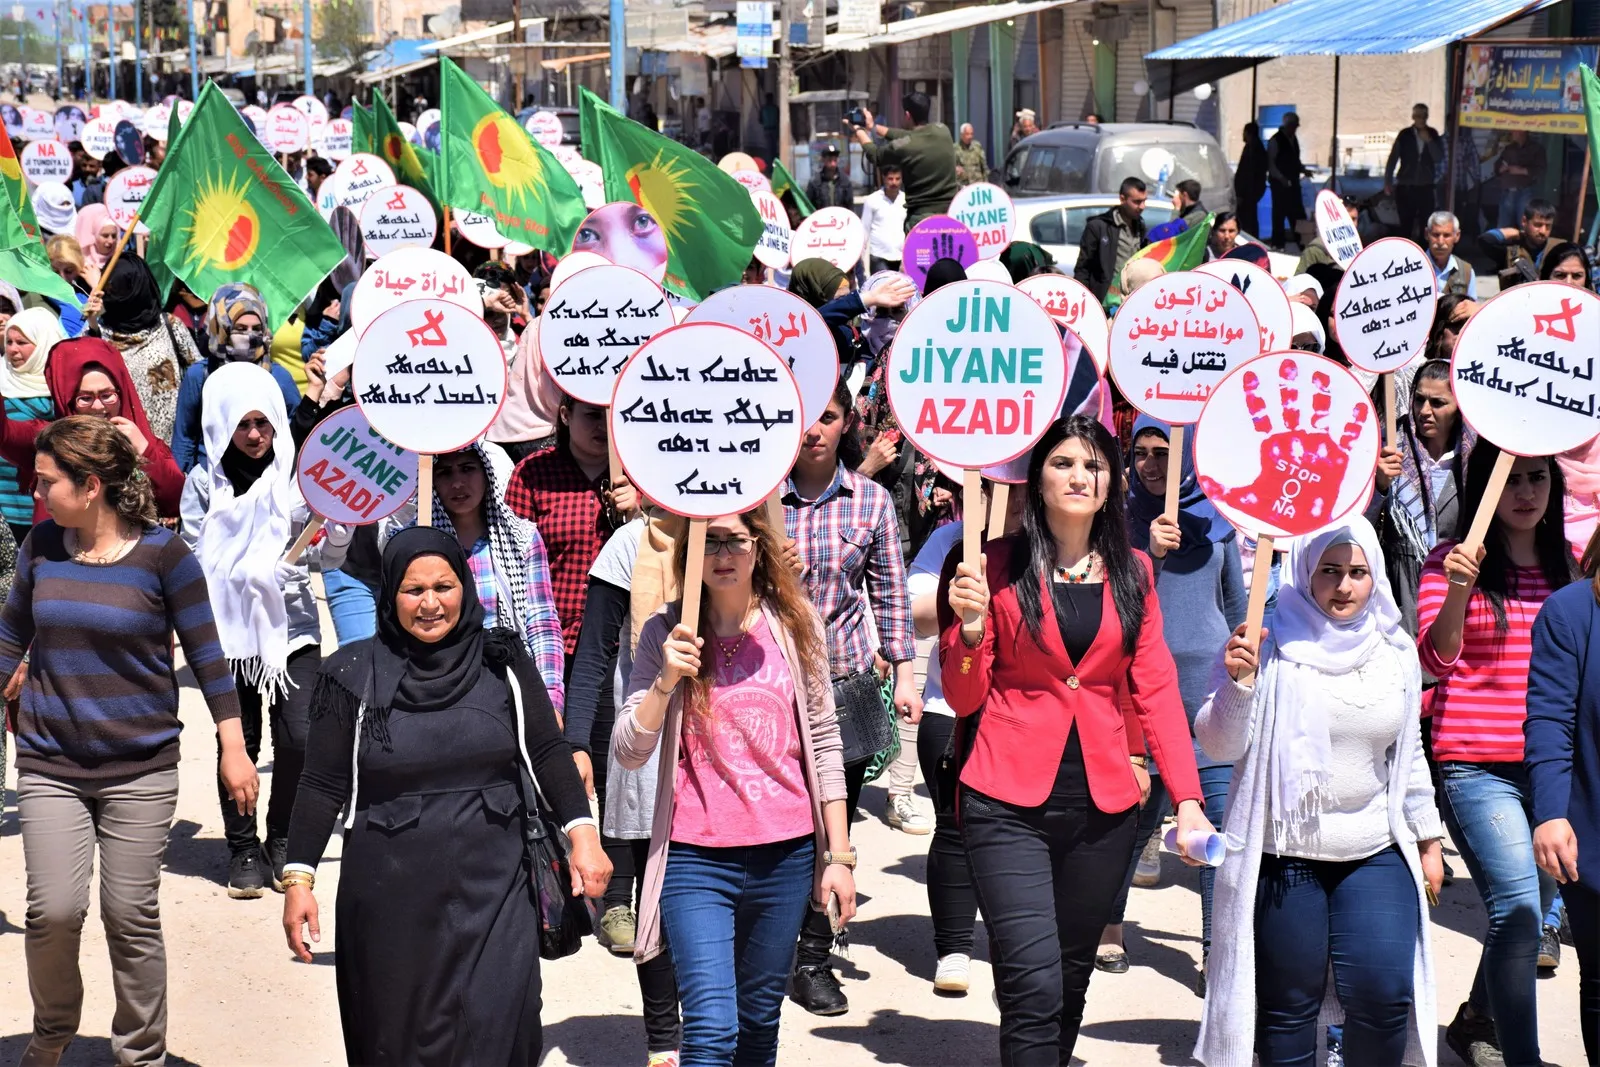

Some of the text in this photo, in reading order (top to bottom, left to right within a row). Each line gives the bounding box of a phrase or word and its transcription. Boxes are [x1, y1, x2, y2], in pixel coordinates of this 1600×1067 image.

[1496, 63, 1561, 95] شام للتجارة
[98, 123, 114, 133] NA
[334, 123, 347, 134] NA
[38, 144, 56, 156] NA
[759, 197, 777, 222] NA
[1323, 198, 1342, 222] NA
[809, 215, 850, 233] ارفع
[974, 224, 1006, 247] ZADÎ
[807, 234, 846, 250] يدك
[374, 269, 465, 298] المرأة حياة
[1154, 284, 1228, 312] لن أكون
[749, 312, 808, 347] المرأة
[1141, 348, 1227, 375] تقتل فيه
[915, 390, 1036, 436] AZADÎ
[1275, 459, 1321, 484] STOP
[303, 458, 385, 519] AZADÎ
[1272, 499, 1296, 519] NA
